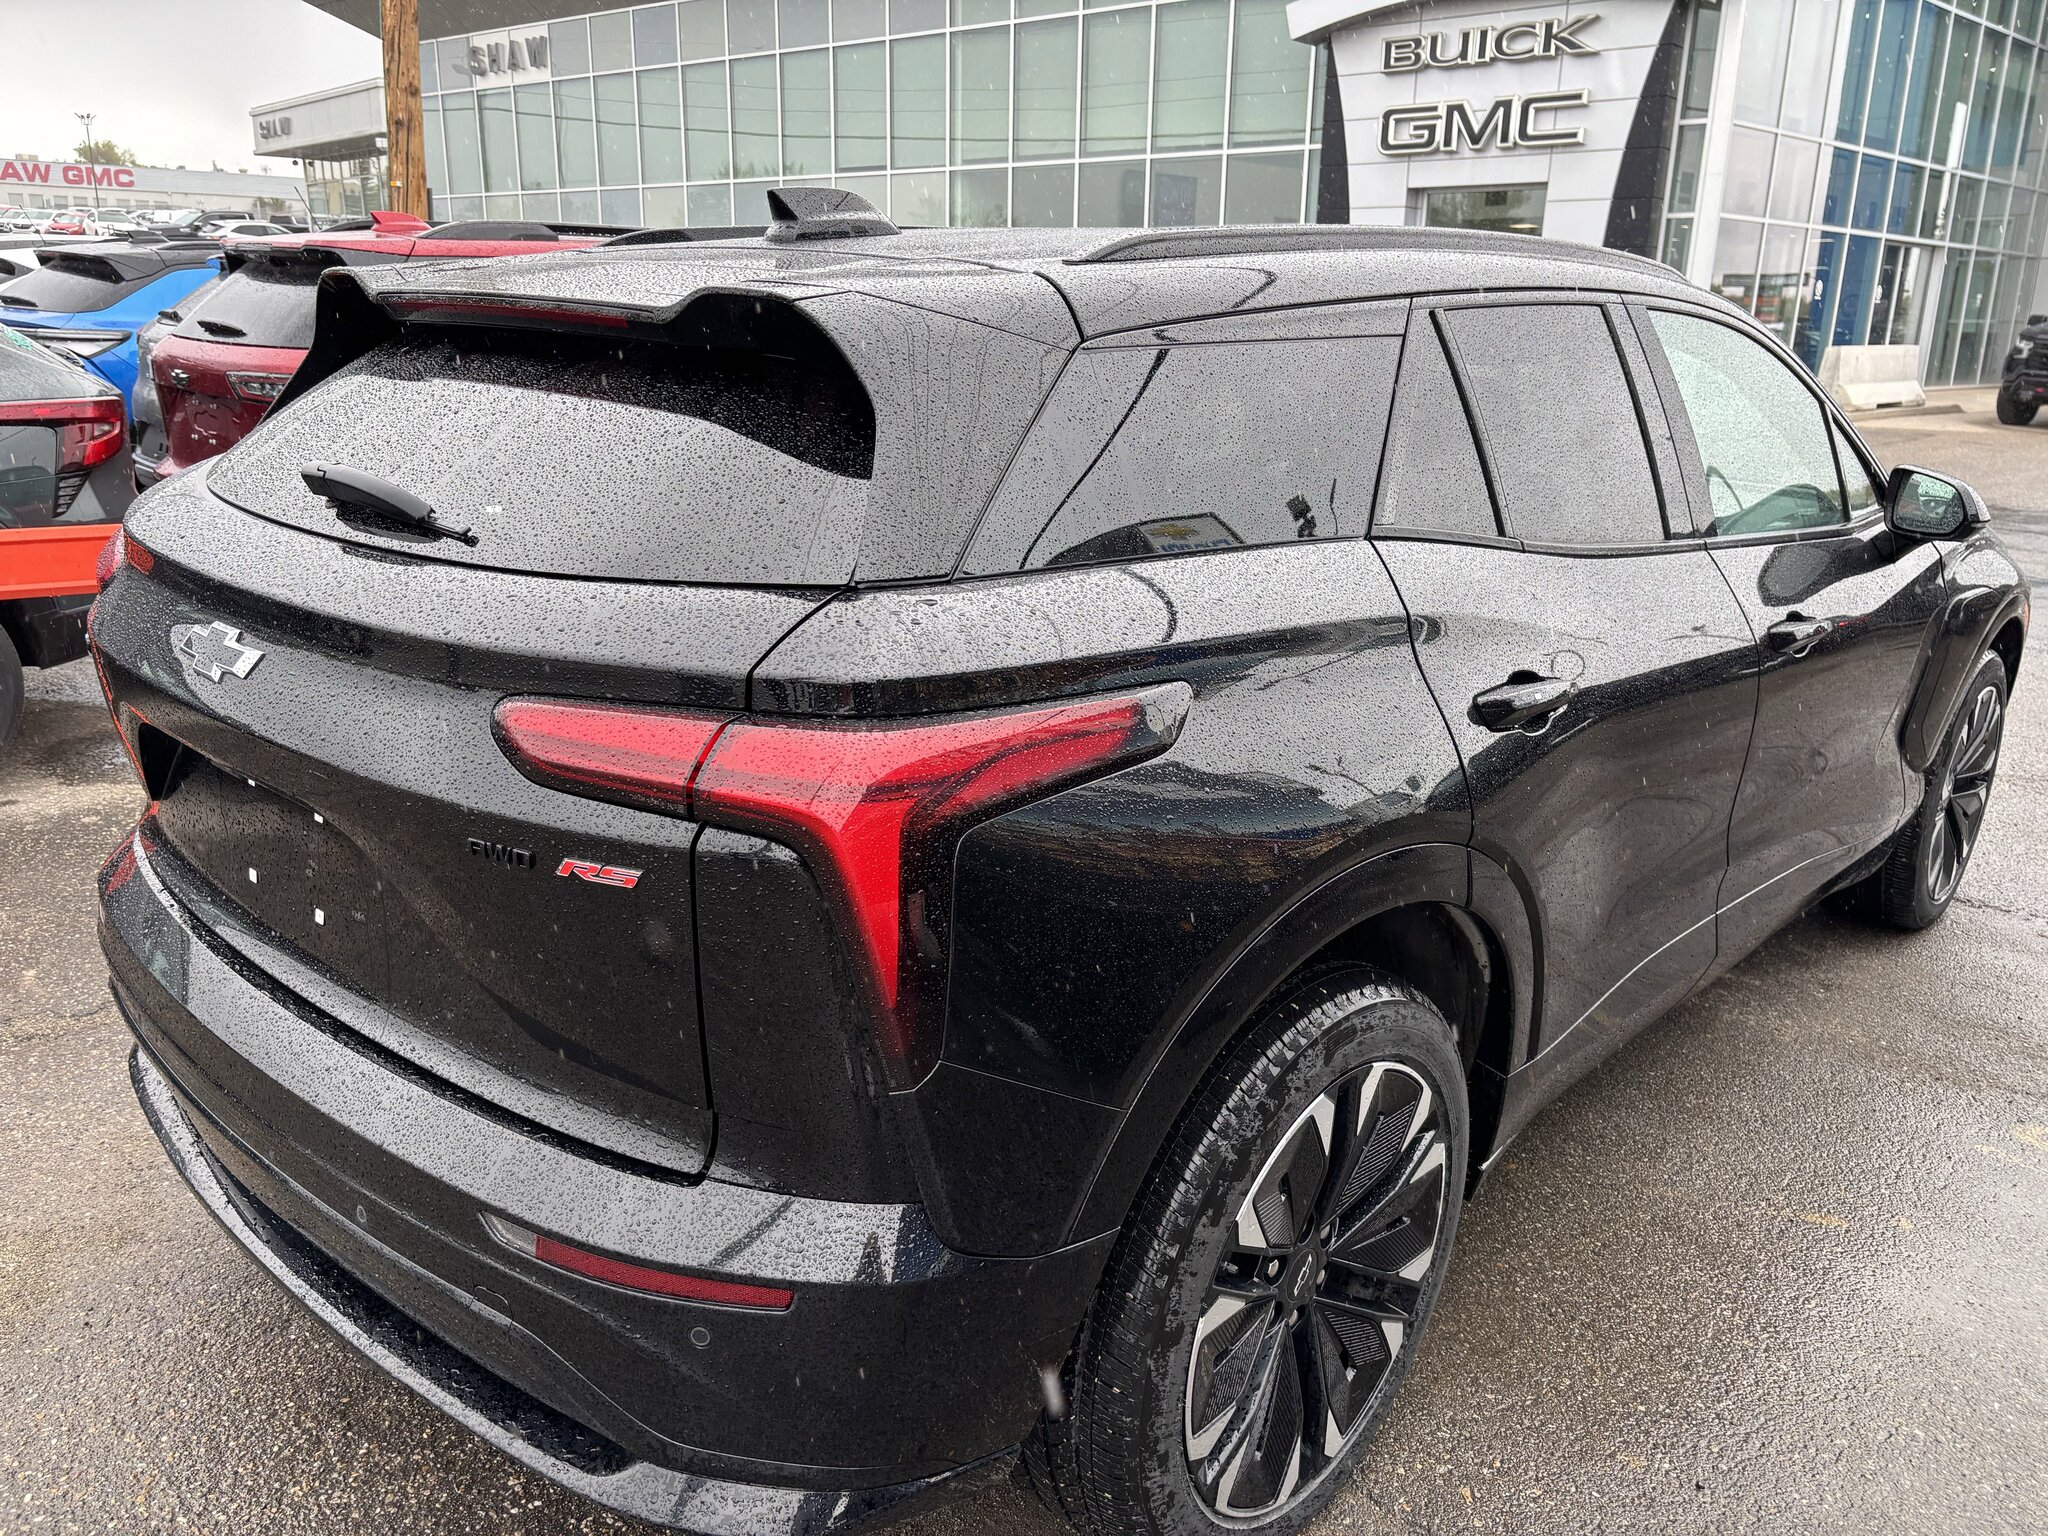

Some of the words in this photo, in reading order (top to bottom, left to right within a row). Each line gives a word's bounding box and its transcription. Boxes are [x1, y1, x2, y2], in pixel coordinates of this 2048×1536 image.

[470, 35, 547, 76] SHAW
[1381, 13, 1600, 75] BUICK
[1378, 87, 1590, 154] GMC
[62, 165, 135, 188] GMC
[555, 857, 645, 888] RS
